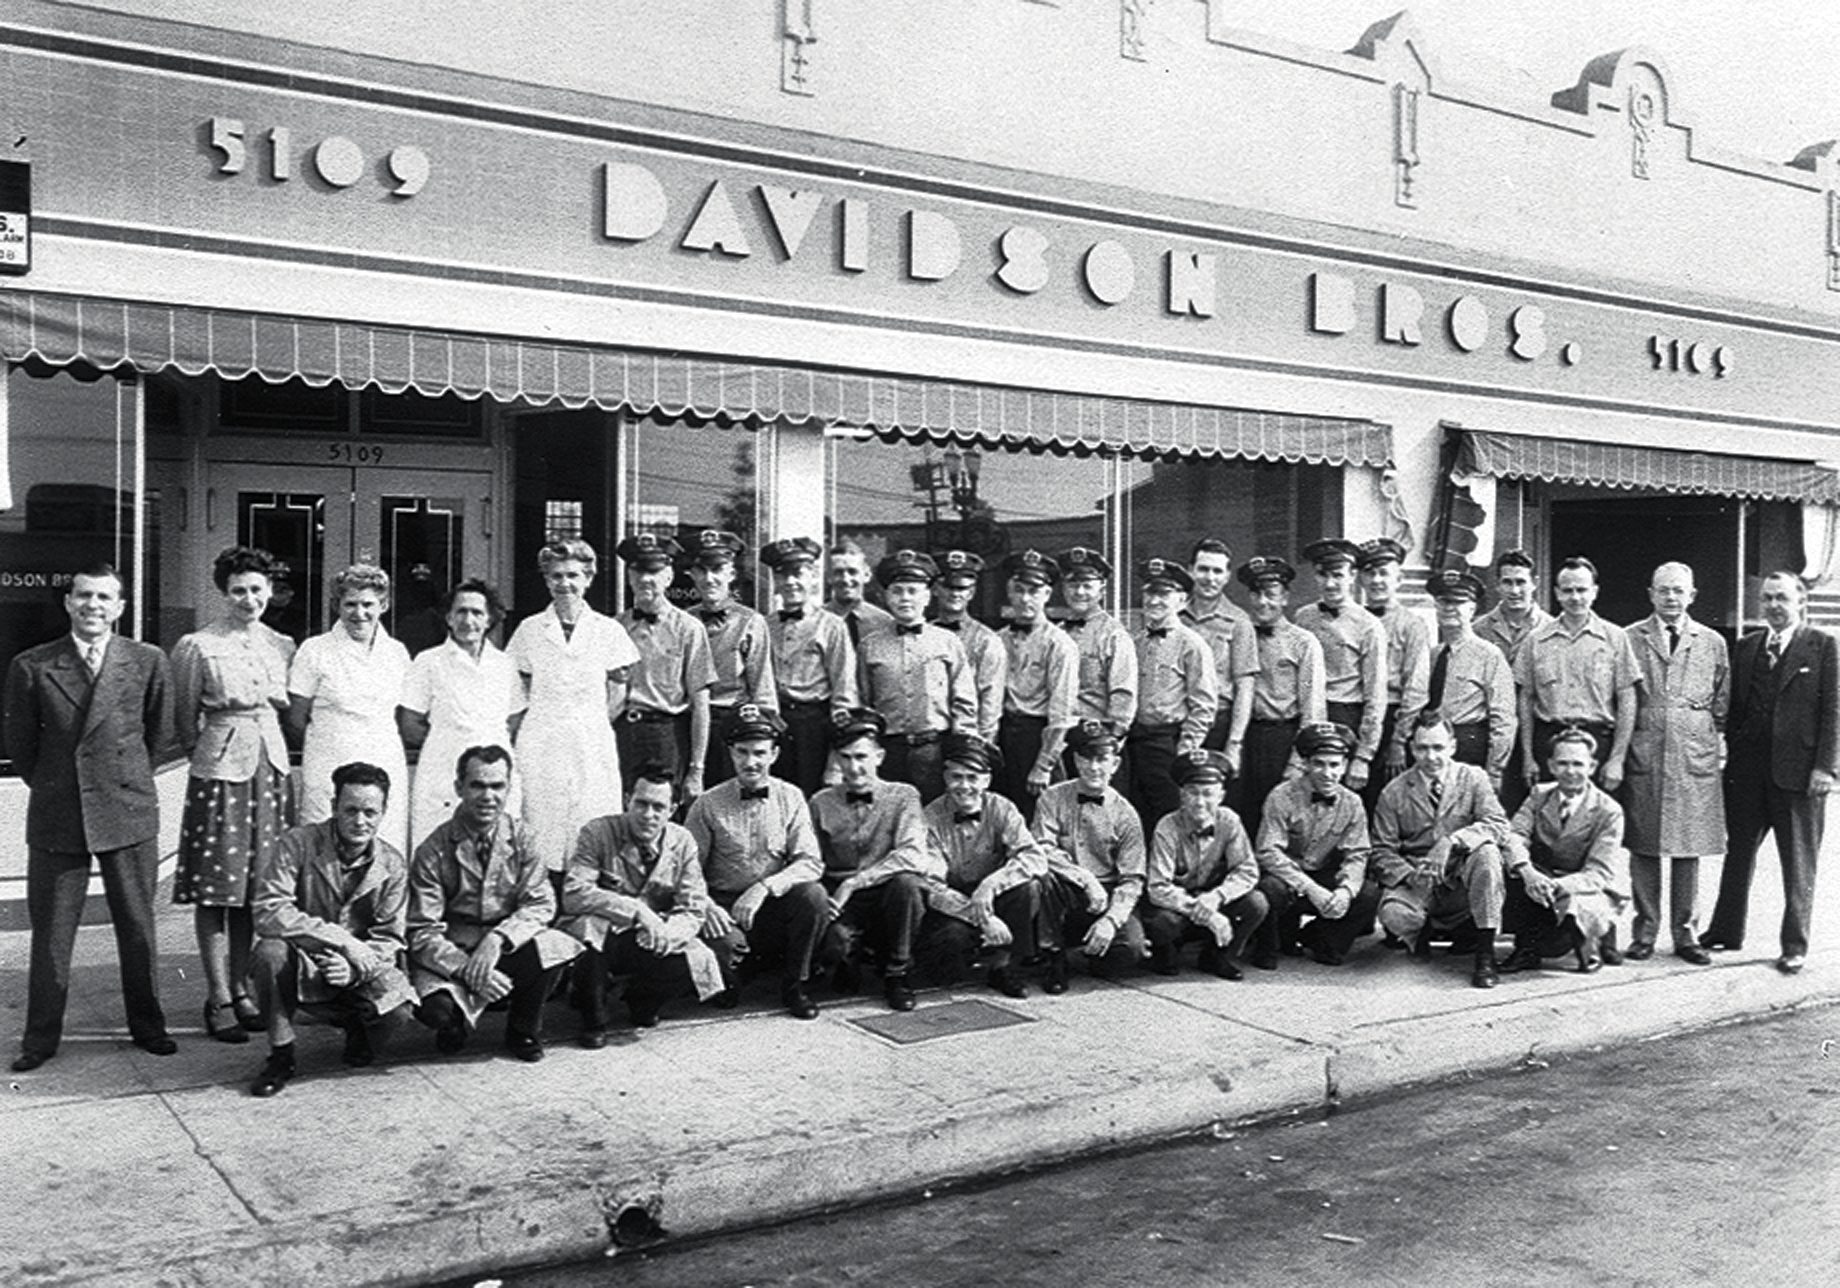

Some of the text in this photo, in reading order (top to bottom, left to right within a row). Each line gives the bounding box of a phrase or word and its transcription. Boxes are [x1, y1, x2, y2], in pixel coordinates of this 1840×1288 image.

[209, 117, 430, 197] 5109
[602, 161, 1582, 366] DAVIDSON BROS.
[329, 443, 383, 464] 5109
